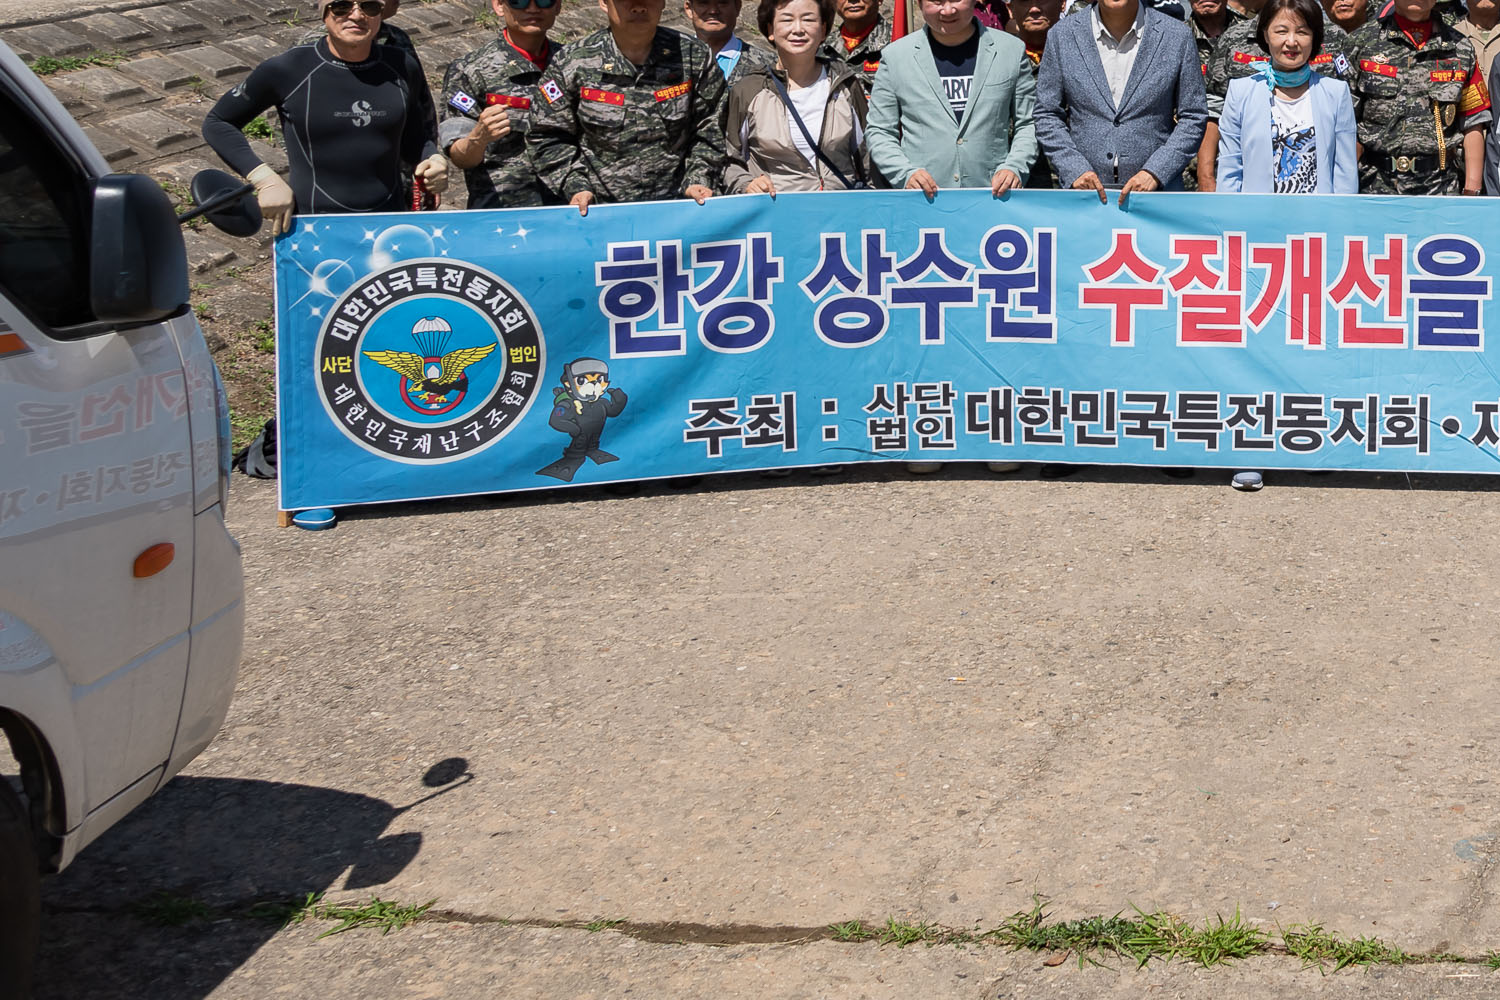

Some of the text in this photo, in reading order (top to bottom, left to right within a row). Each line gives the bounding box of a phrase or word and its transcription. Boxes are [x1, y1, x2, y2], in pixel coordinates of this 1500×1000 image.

[943, 78, 974, 100] ARV
[330, 266, 527, 342] 대한민국특전동지회
[595, 231, 783, 359] 한강
[798, 224, 1059, 348] 상수원
[1078, 228, 1492, 352] 수질개선을
[322, 355, 353, 375] 사단
[509, 345, 537, 364] 법인
[333, 370, 534, 456] 대한민국재난구조협회
[862, 381, 958, 415] 사단
[684, 391, 797, 457] 주최
[867, 416, 957, 452] 법인
